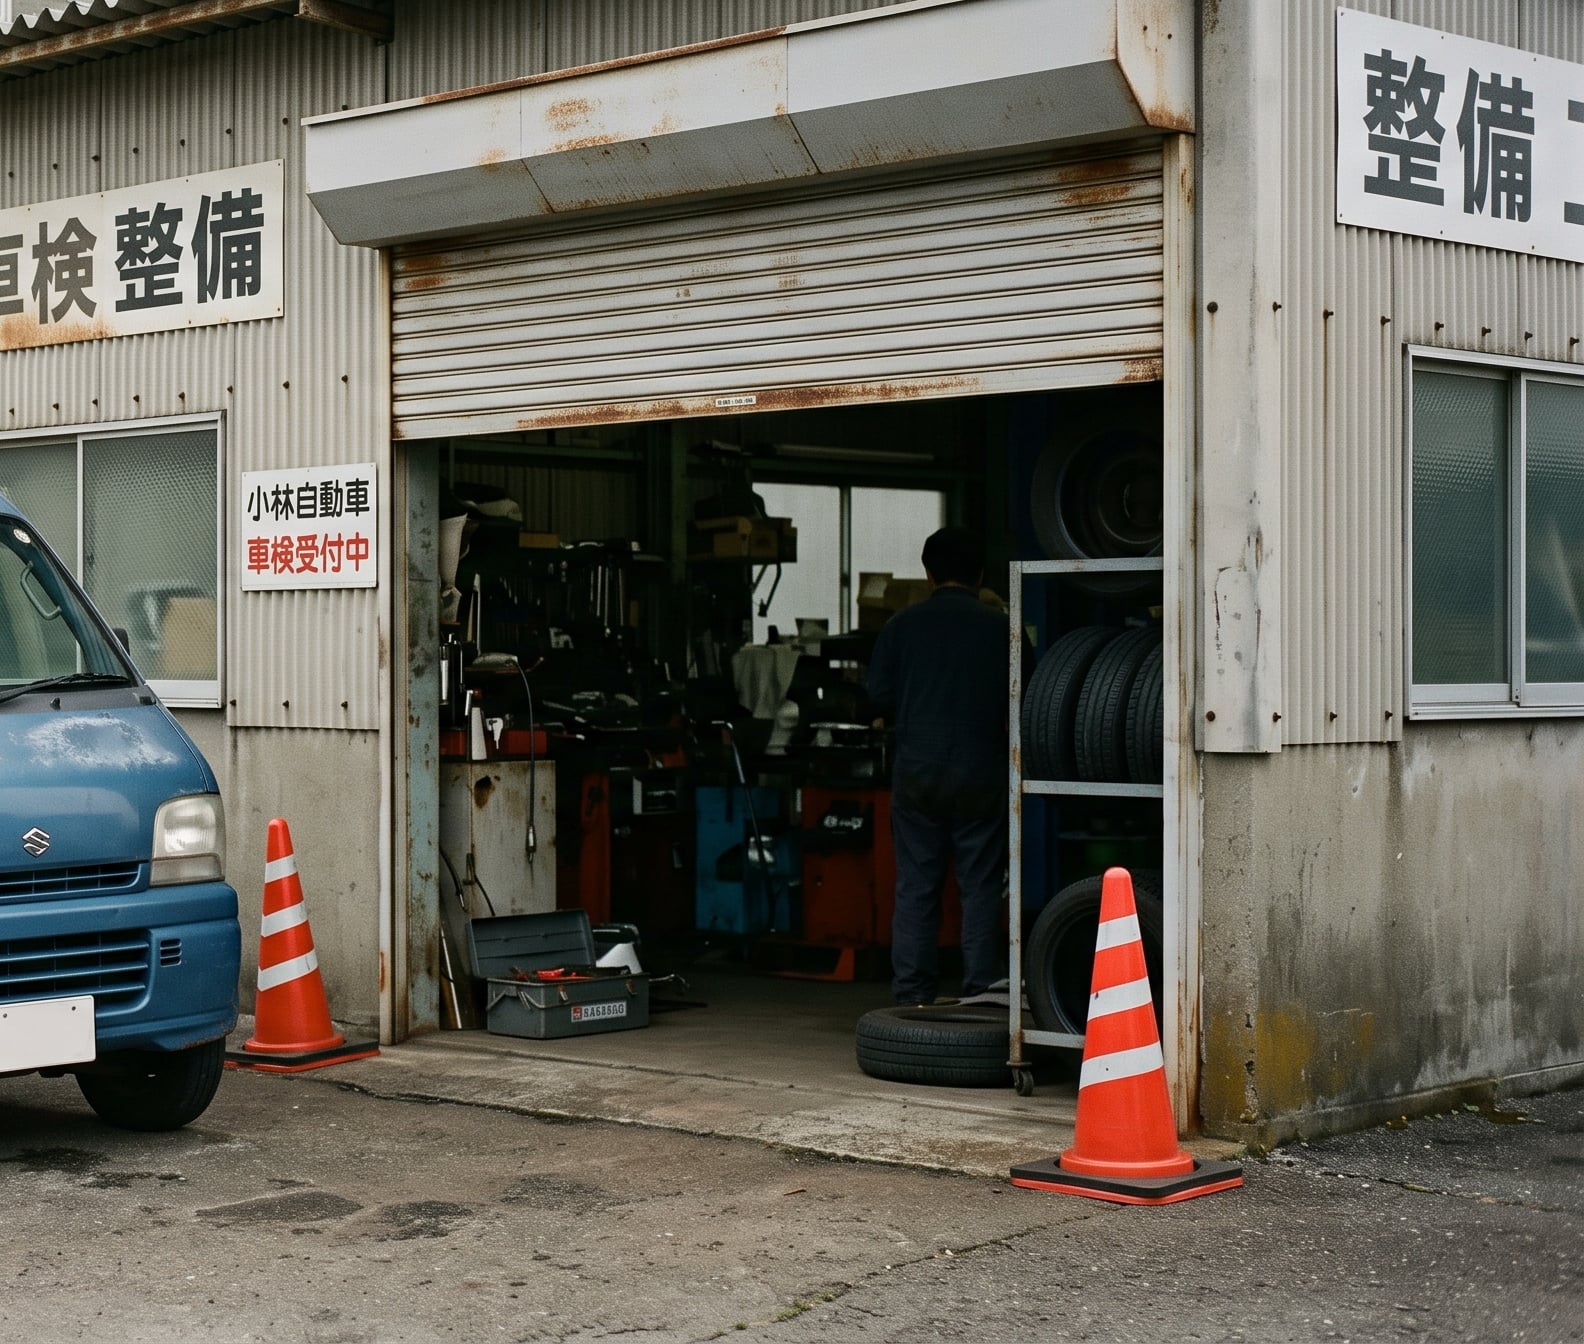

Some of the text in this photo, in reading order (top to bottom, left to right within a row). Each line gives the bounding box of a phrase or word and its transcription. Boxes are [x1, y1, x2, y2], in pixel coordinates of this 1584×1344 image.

[1363, 48, 1584, 226] 整備
[247, 478, 370, 521] 小林自動車
[247, 532, 369, 575] 車検受付中
